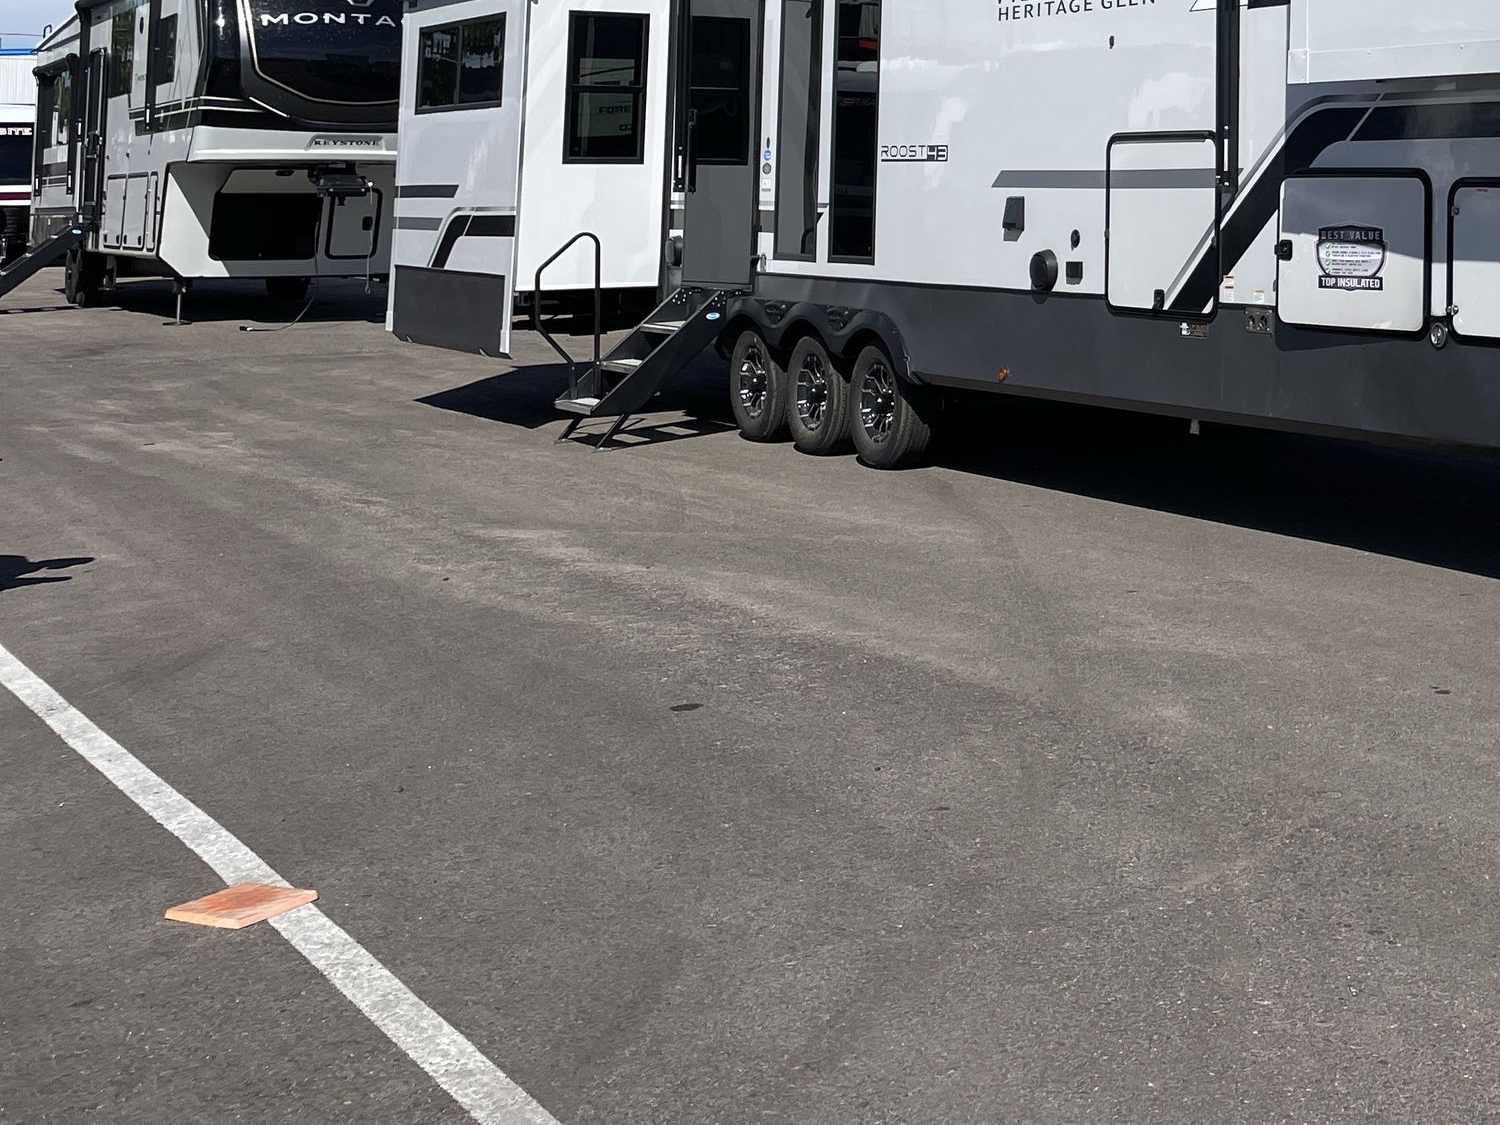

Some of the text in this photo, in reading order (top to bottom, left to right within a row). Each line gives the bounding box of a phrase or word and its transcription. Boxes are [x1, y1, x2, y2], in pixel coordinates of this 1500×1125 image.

[260, 12, 403, 27] MONTA
[1320, 230, 1381, 240] BEST VALUE
[1320, 277, 1381, 288] TOP INSULATED
